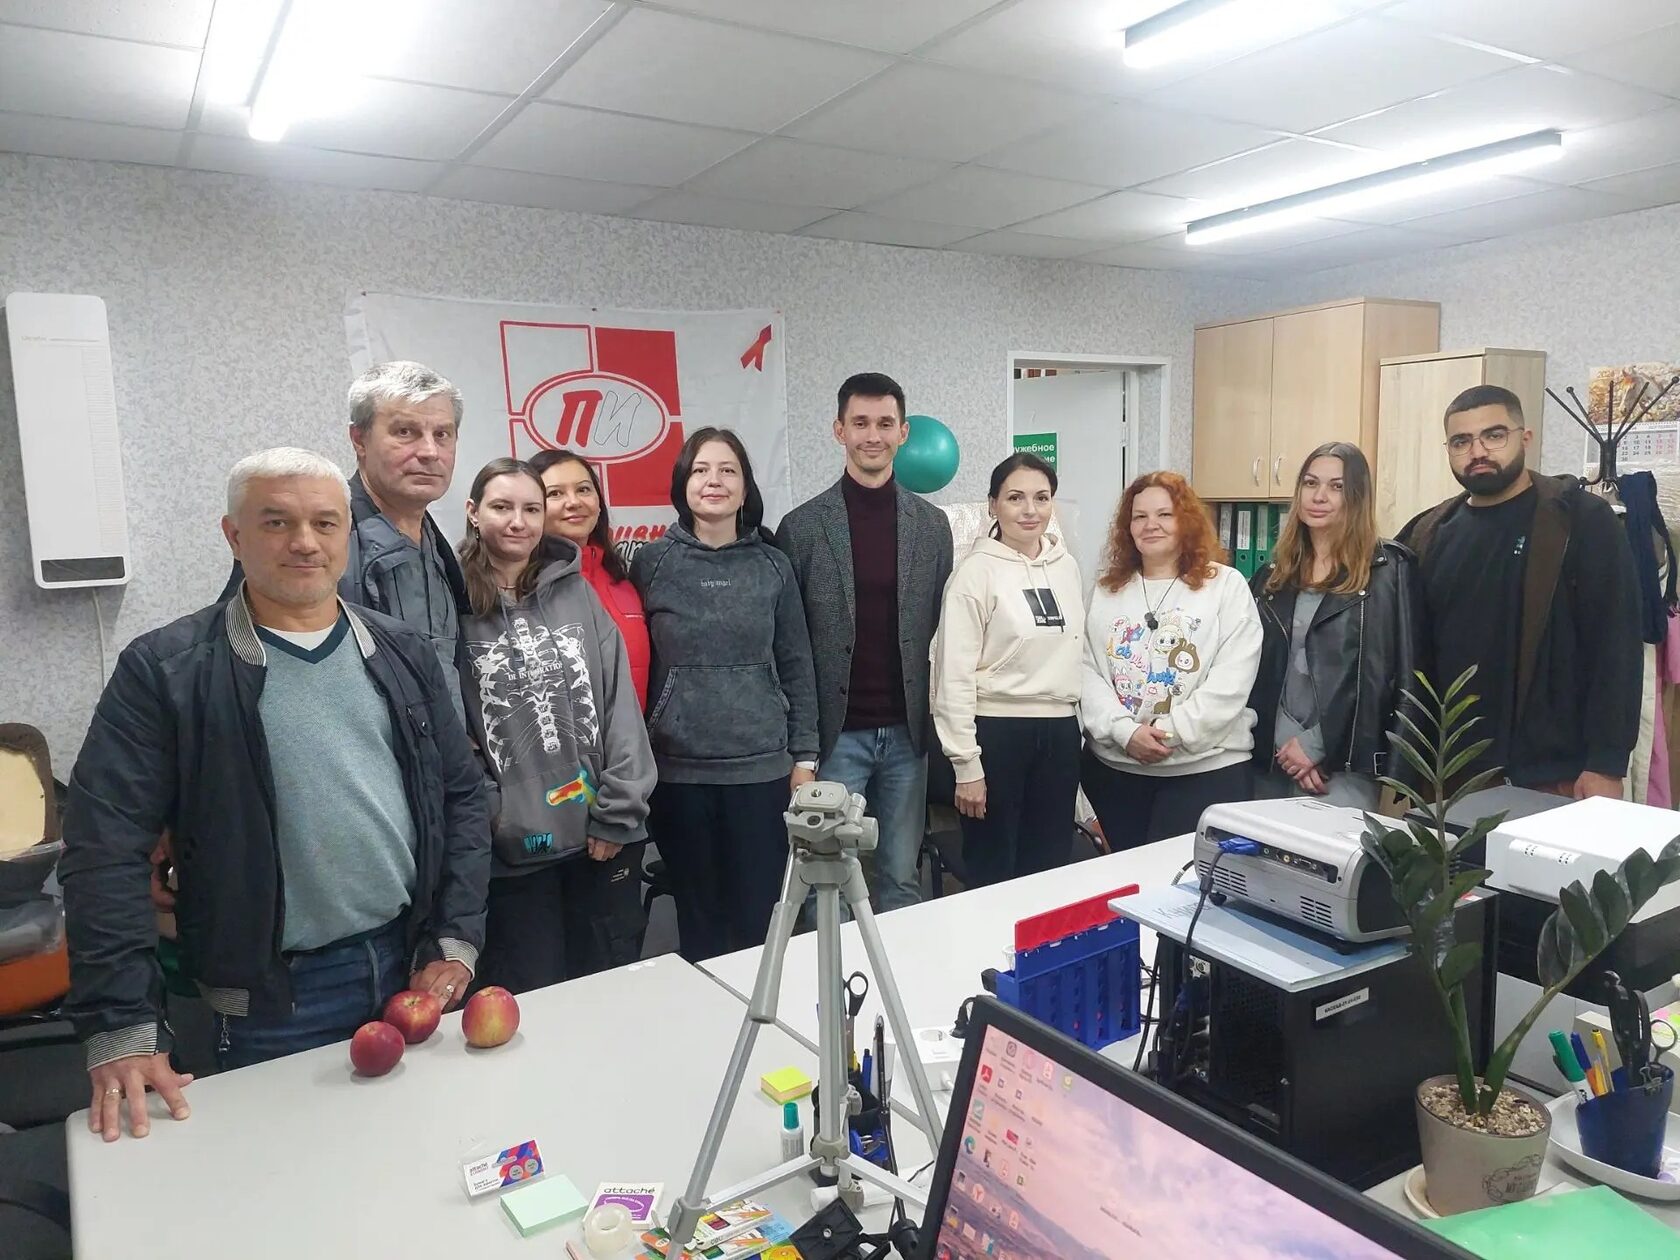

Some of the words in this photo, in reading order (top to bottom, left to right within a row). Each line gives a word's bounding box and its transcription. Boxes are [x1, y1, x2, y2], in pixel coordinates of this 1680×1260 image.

[555, 389, 642, 448] ПИ
[1013, 443, 1055, 454] ужебное
[603, 1186, 656, 1194] attaché
